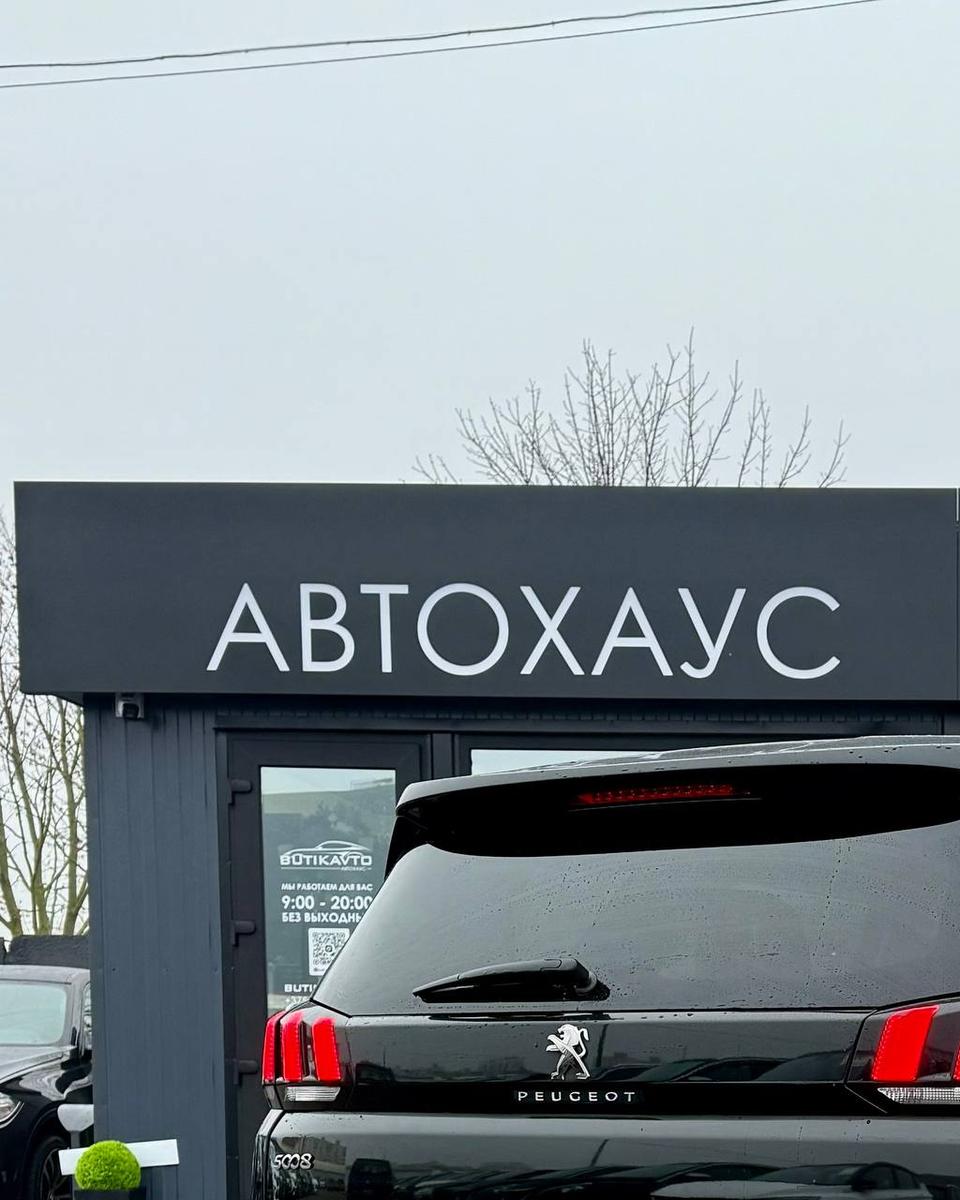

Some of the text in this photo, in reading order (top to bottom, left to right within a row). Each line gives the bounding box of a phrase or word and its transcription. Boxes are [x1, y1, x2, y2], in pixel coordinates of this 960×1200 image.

[206, 582, 842, 680] АВТОХАУС
[280, 855, 372, 866] BUTIKAVTO
[282, 895, 314, 910] 9:00
[330, 895, 373, 910] 20:00
[282, 912, 301, 922] БЕЗ
[517, 1091, 636, 1103] PEUGEOT
[274, 1153, 312, 1170] 5008
